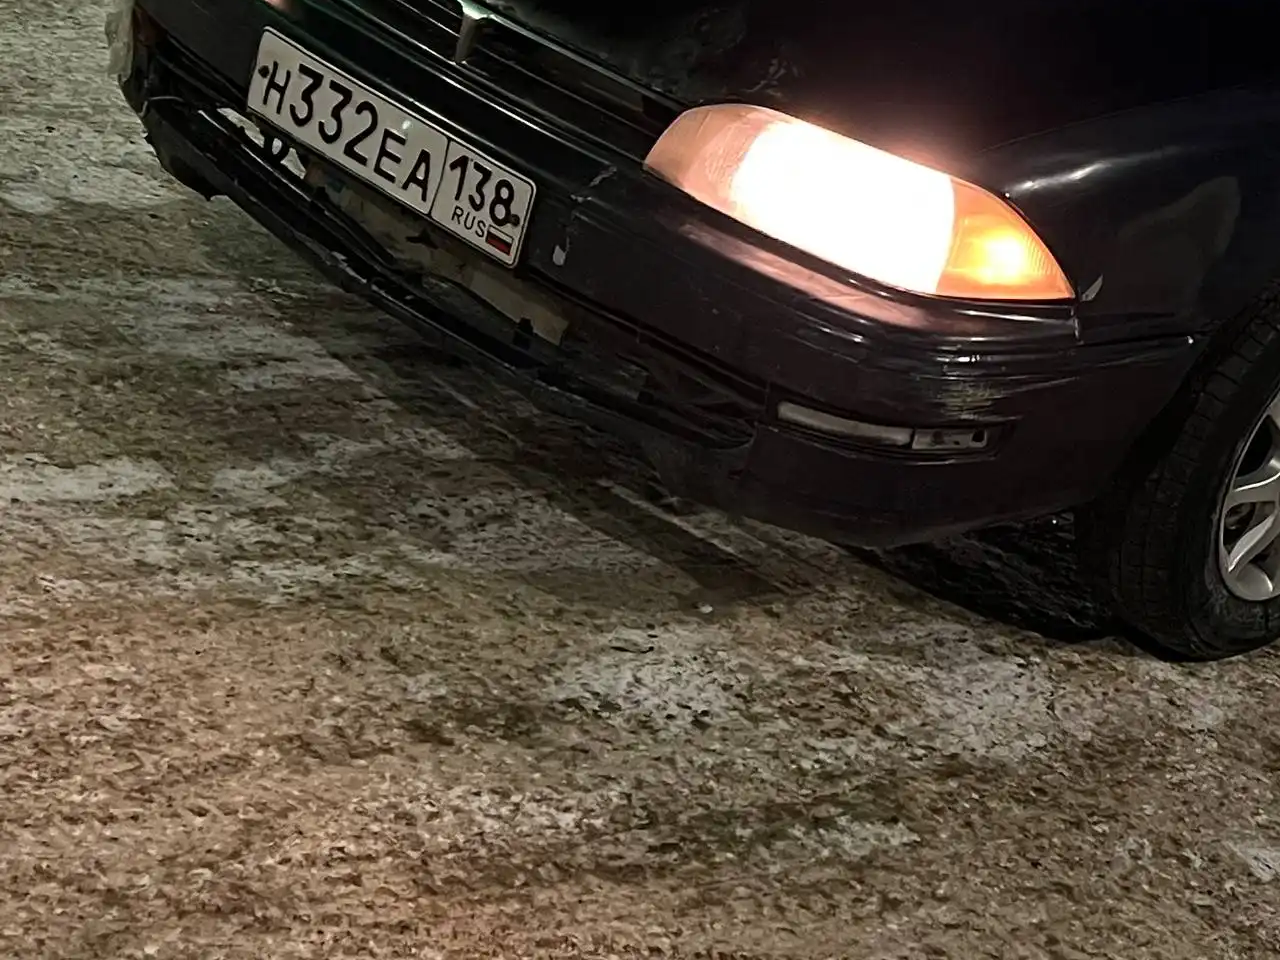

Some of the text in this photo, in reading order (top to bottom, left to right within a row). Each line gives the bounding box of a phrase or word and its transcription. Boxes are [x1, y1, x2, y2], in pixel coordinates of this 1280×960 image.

[262, 60, 516, 228] Н332ЕА 138
[451, 206, 487, 238] RUS
